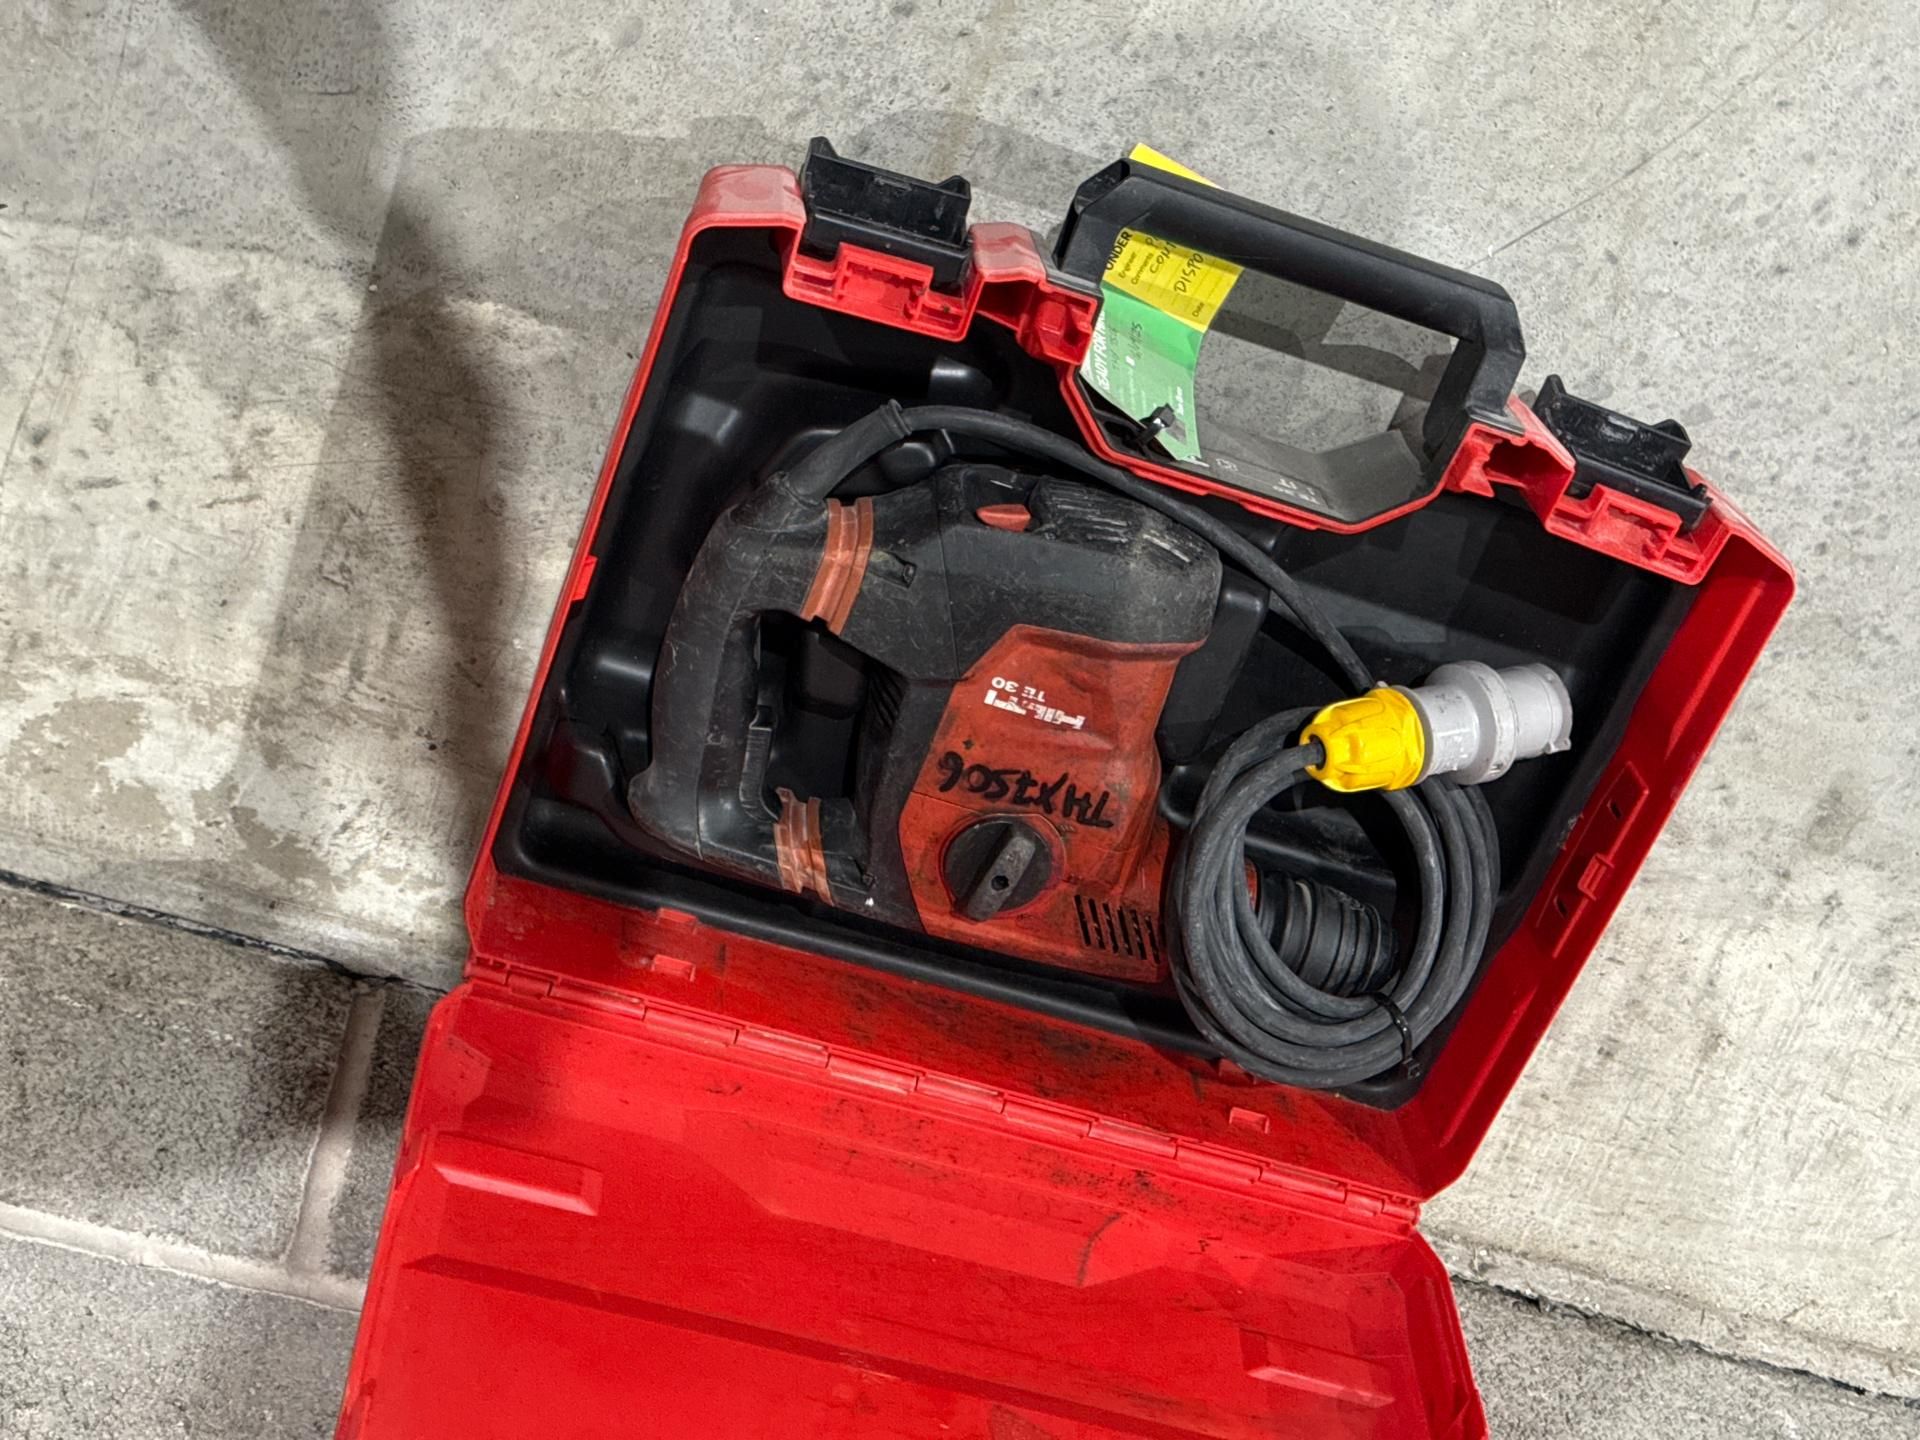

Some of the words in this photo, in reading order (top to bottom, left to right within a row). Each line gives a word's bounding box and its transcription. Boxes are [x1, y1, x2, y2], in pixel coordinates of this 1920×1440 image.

[1105, 231, 1133, 271] UNDER
[991, 676, 1019, 693] 30
[1021, 686, 1046, 703] TE
[984, 689, 1086, 730] HILTI
